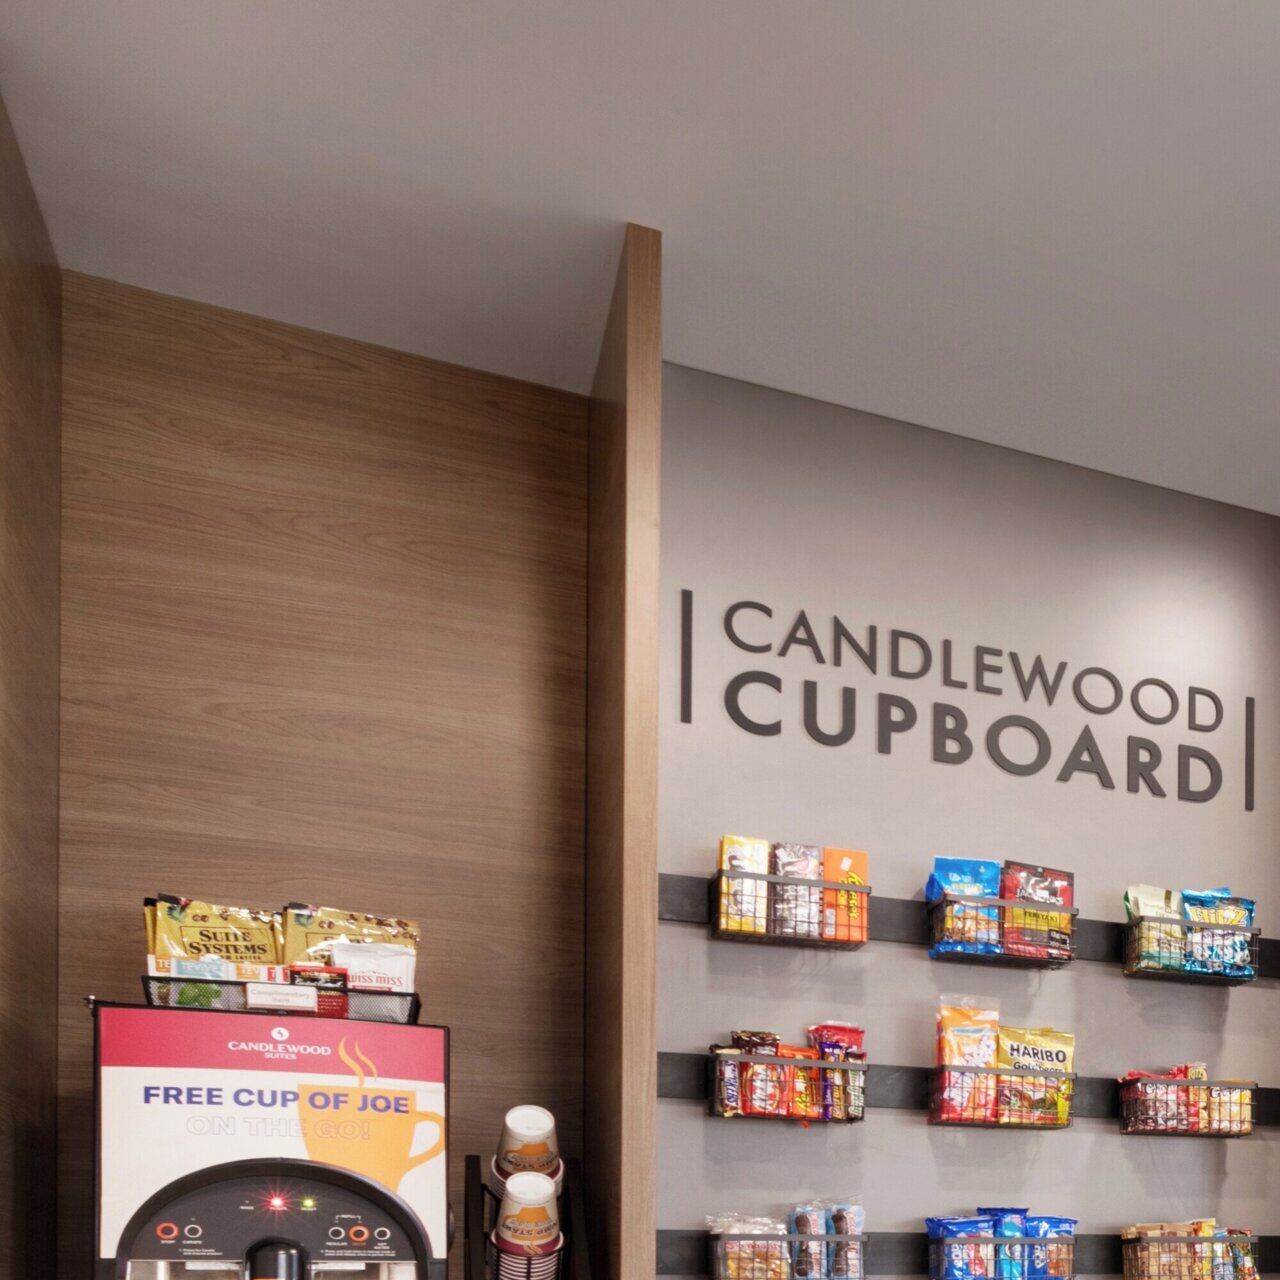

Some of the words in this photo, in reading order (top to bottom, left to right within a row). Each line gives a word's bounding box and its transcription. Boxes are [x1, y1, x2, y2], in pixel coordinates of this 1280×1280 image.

[723, 600, 1224, 732] CANDLEWOOD
[723, 670, 1223, 803] CUPBOARD
[189, 941, 267, 955] SYSTEMS
[348, 974, 374, 983] WISS
[378, 975, 402, 985] MISS
[227, 1041, 331, 1056] CANDLEWOOD
[264, 1052, 296, 1060] SUITES
[1010, 1043, 1066, 1063] HARIBO
[143, 1085, 224, 1106] FREE
[233, 1088, 300, 1108] CUP
[308, 1091, 348, 1111] OF
[357, 1094, 410, 1115] JOE
[186, 1115, 236, 1136] ON
[248, 1117, 305, 1138] THE
[313, 1120, 371, 1141] GO!
